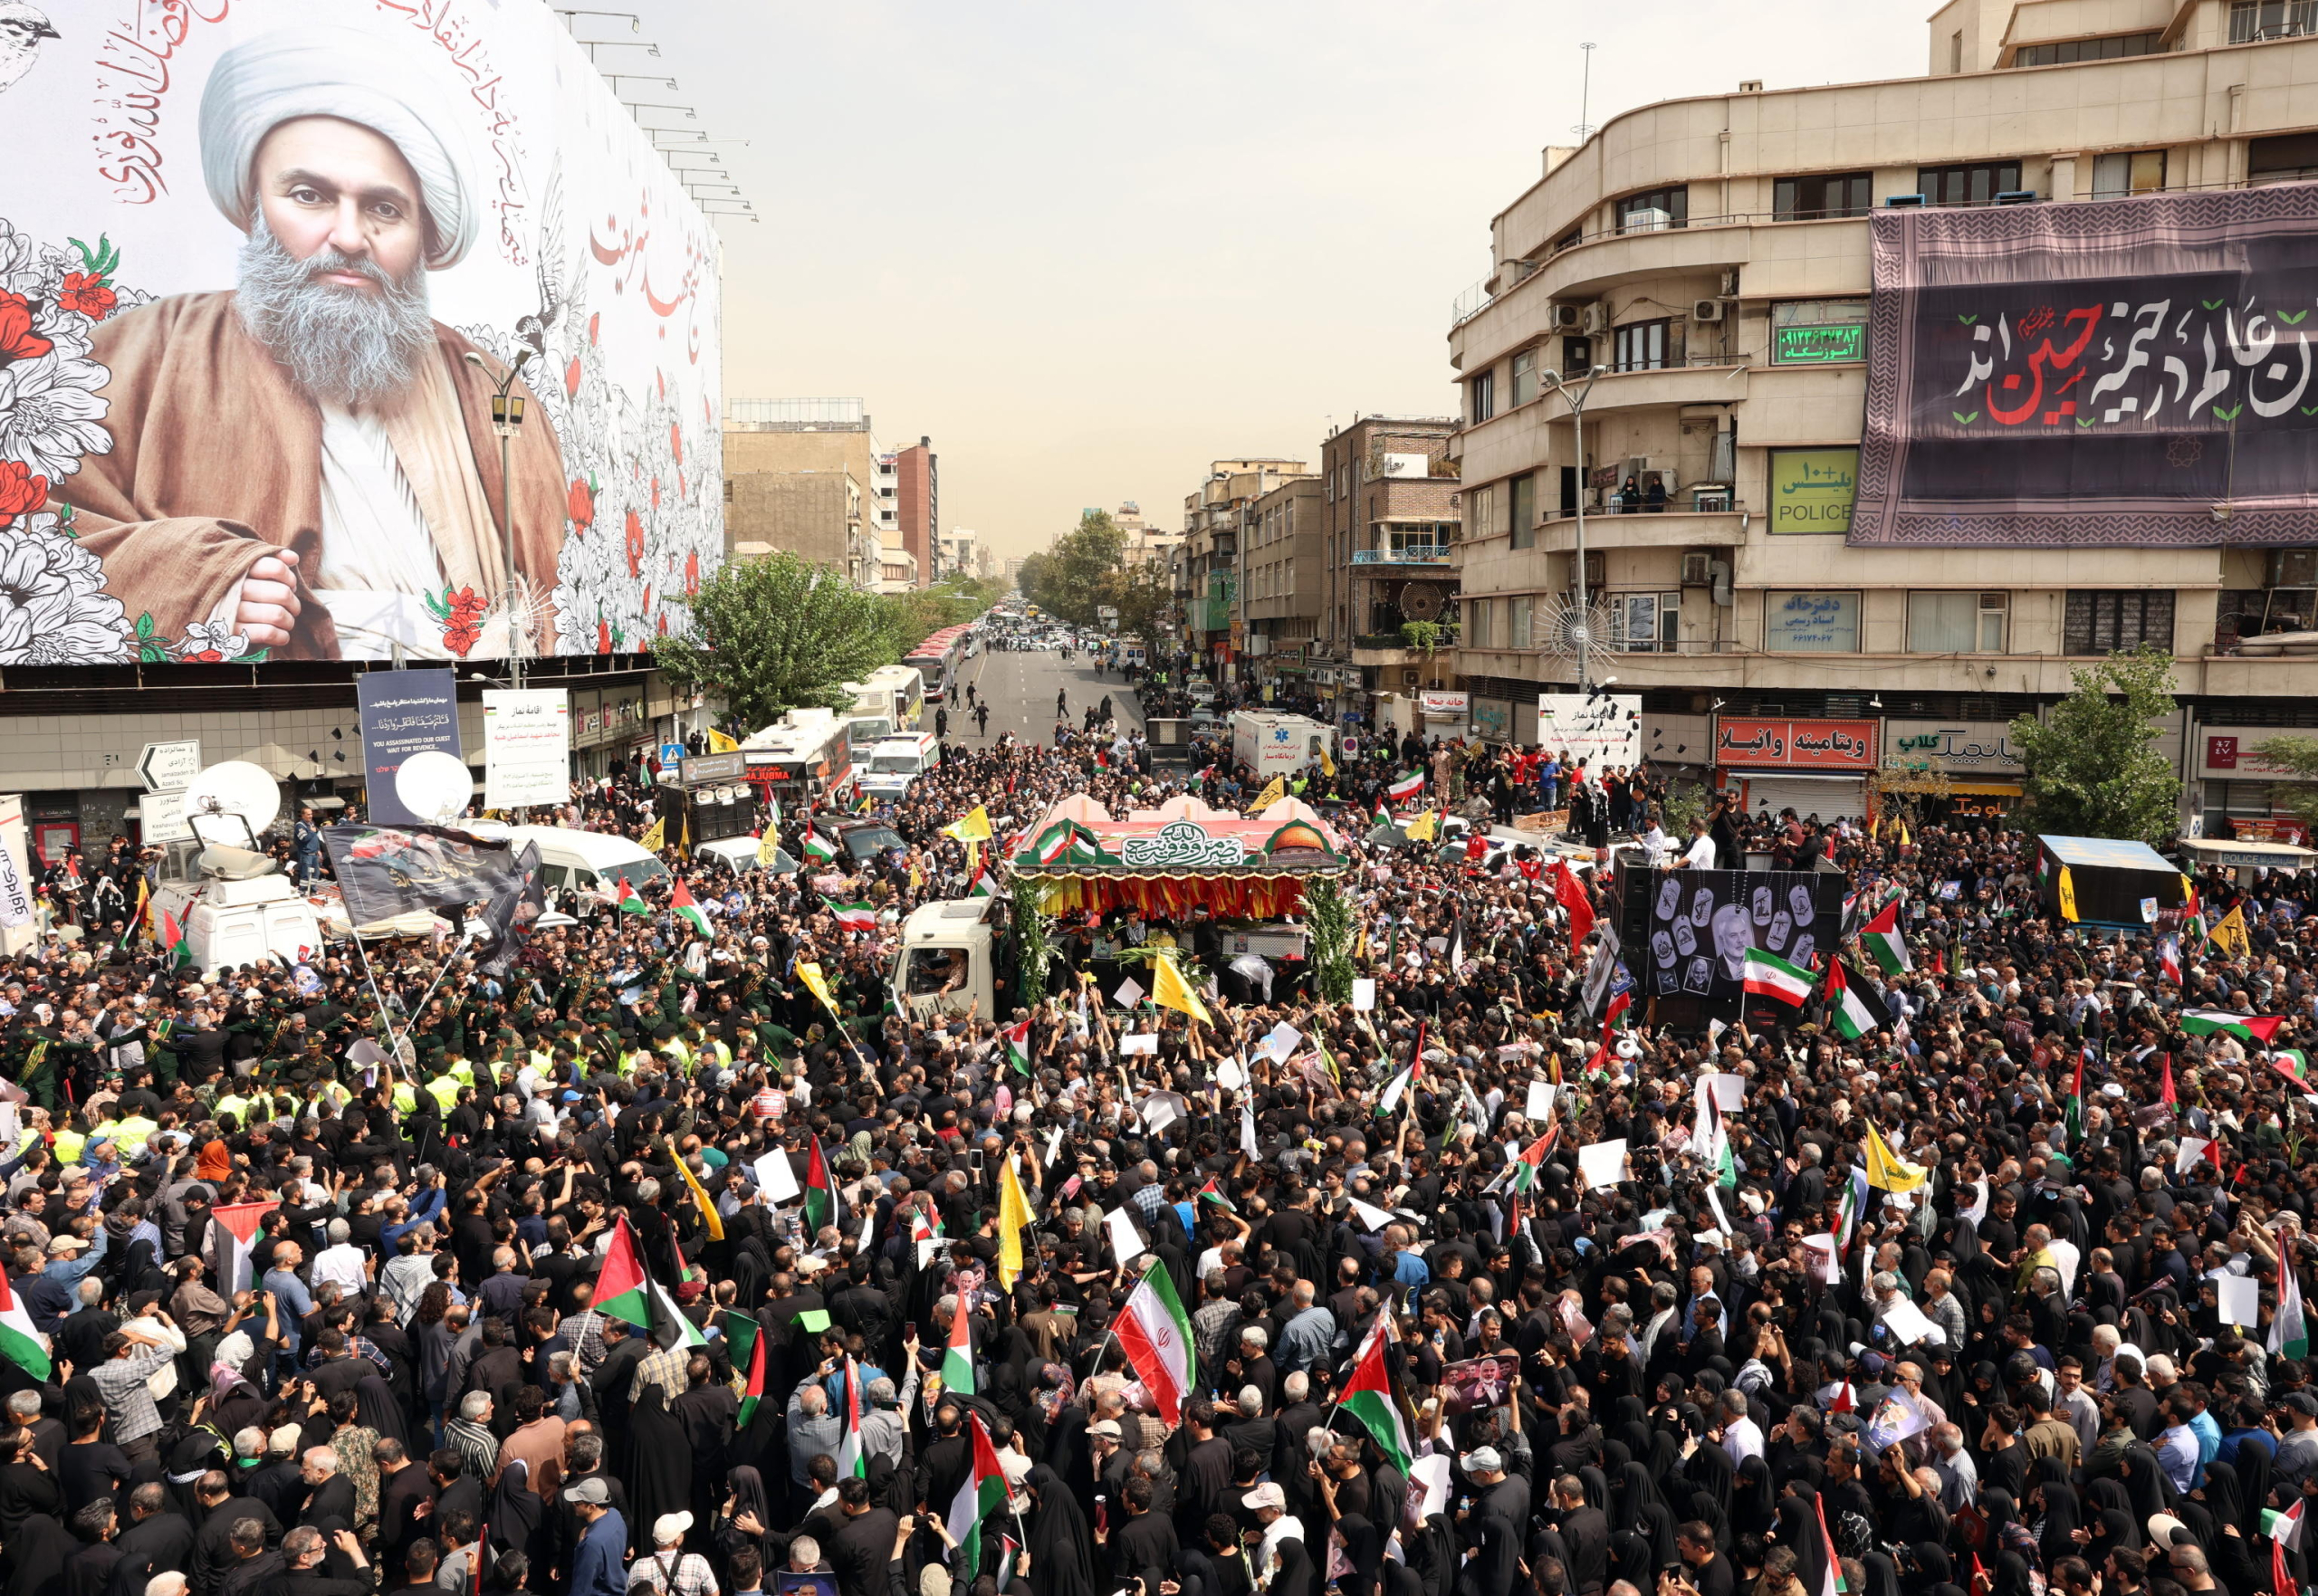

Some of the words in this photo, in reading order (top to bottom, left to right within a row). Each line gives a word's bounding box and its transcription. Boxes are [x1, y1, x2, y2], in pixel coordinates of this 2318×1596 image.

[1782, 471, 1853, 494] پلیس
[1779, 503, 1853, 521] POLICE
[1783, 596, 1840, 616] دفترخانه
[1785, 616, 1811, 627] رسمی
[1812, 615, 1834, 625] اسناد
[1445, 696, 1464, 706] خانه
[511, 705, 525, 718] نماز
[1571, 710, 1588, 722] نماز
[385, 737, 423, 746] ASSASSINATED
[1565, 735, 1593, 744] اسماعیل
[1720, 727, 1784, 758] وانیلا
[1793, 730, 1866, 759] ویتامینه
[1898, 734, 1940, 752] کلاب
[2215, 740, 2232, 748] 47
[1273, 752, 1296, 761] درمانگاه
[168, 758, 187, 768] آزادی
[159, 796, 181, 807] کشاورز
[2223, 854, 2258, 865] POLICE
